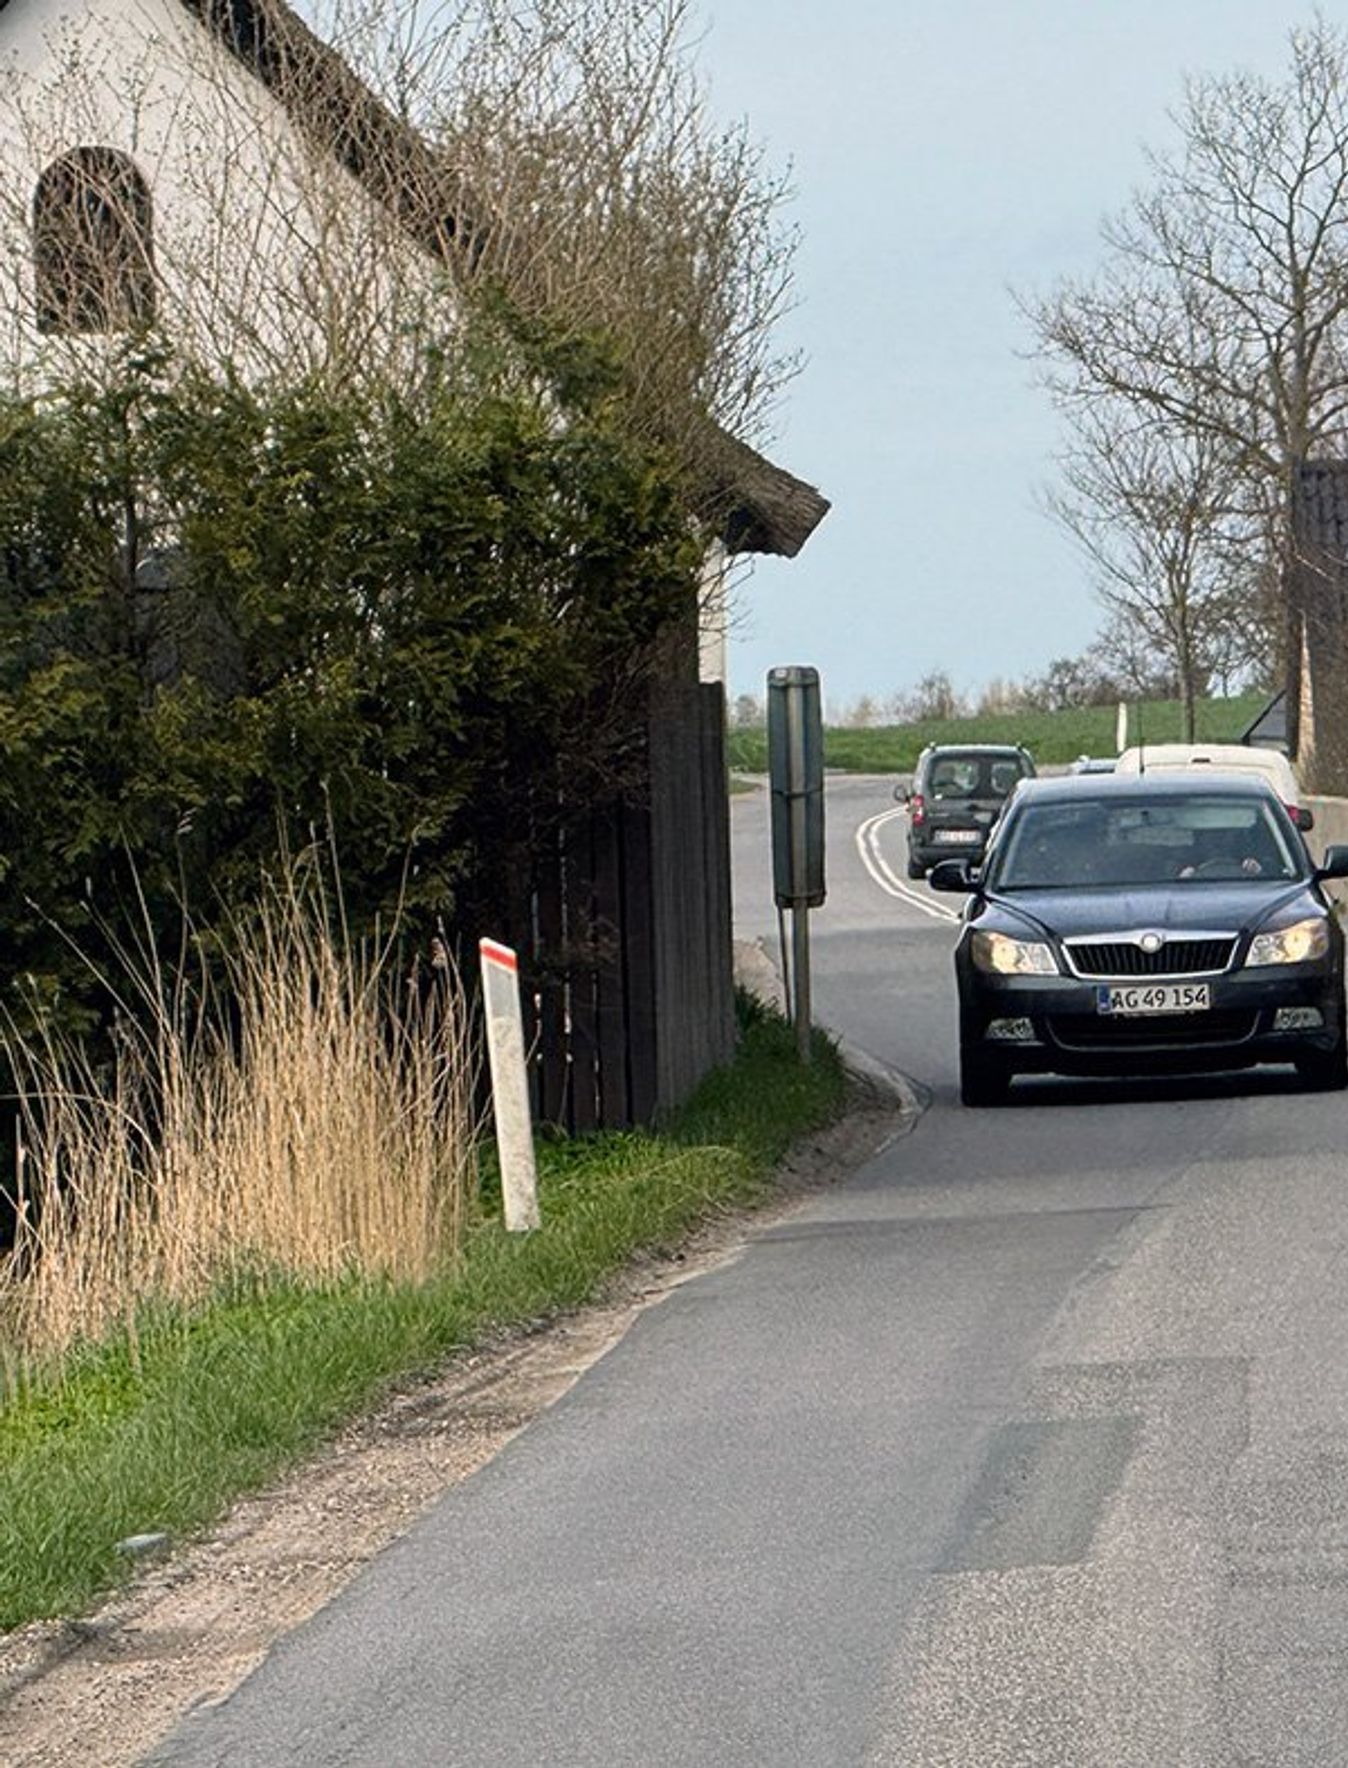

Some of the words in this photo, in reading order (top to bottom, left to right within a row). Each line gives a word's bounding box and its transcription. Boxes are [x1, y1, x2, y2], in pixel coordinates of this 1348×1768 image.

[1111, 989, 1139, 1009] AG
[1143, 988, 1166, 1008] 49
[1172, 986, 1207, 1007] 154
